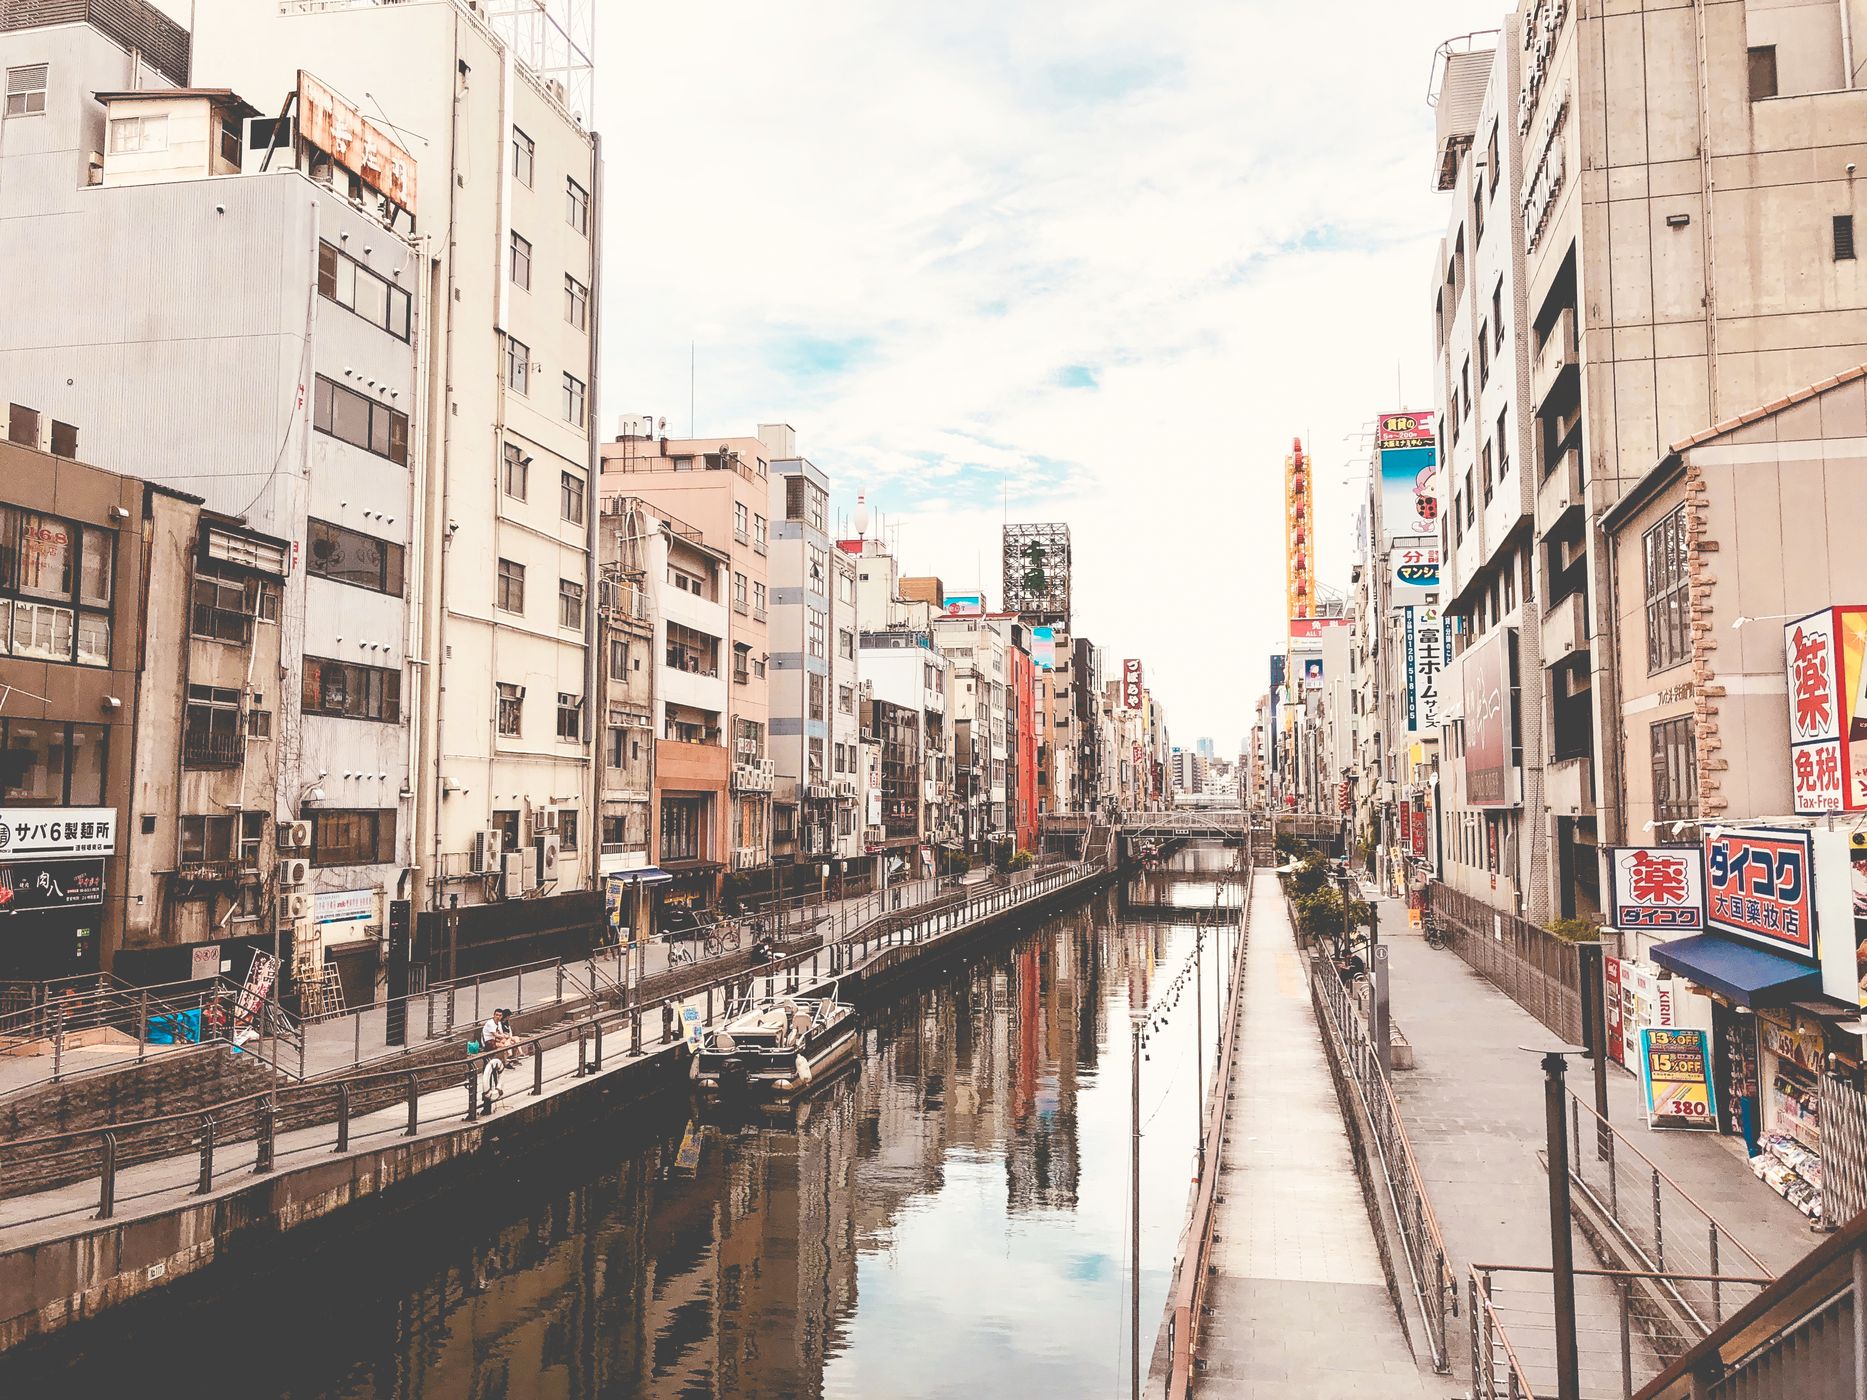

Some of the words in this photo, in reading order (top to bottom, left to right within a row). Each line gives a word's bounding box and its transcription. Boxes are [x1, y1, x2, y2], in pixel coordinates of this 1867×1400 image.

[1418, 628, 1441, 728] 富士ホームサービス
[1795, 746, 1840, 793] 免税
[1798, 794, 1840, 810] Tax-Free
[1628, 853, 1688, 904] 薬
[1709, 840, 1804, 905] ダイコク
[1623, 908, 1696, 925] ダイコク
[1659, 990, 1671, 1026] KIRIN
